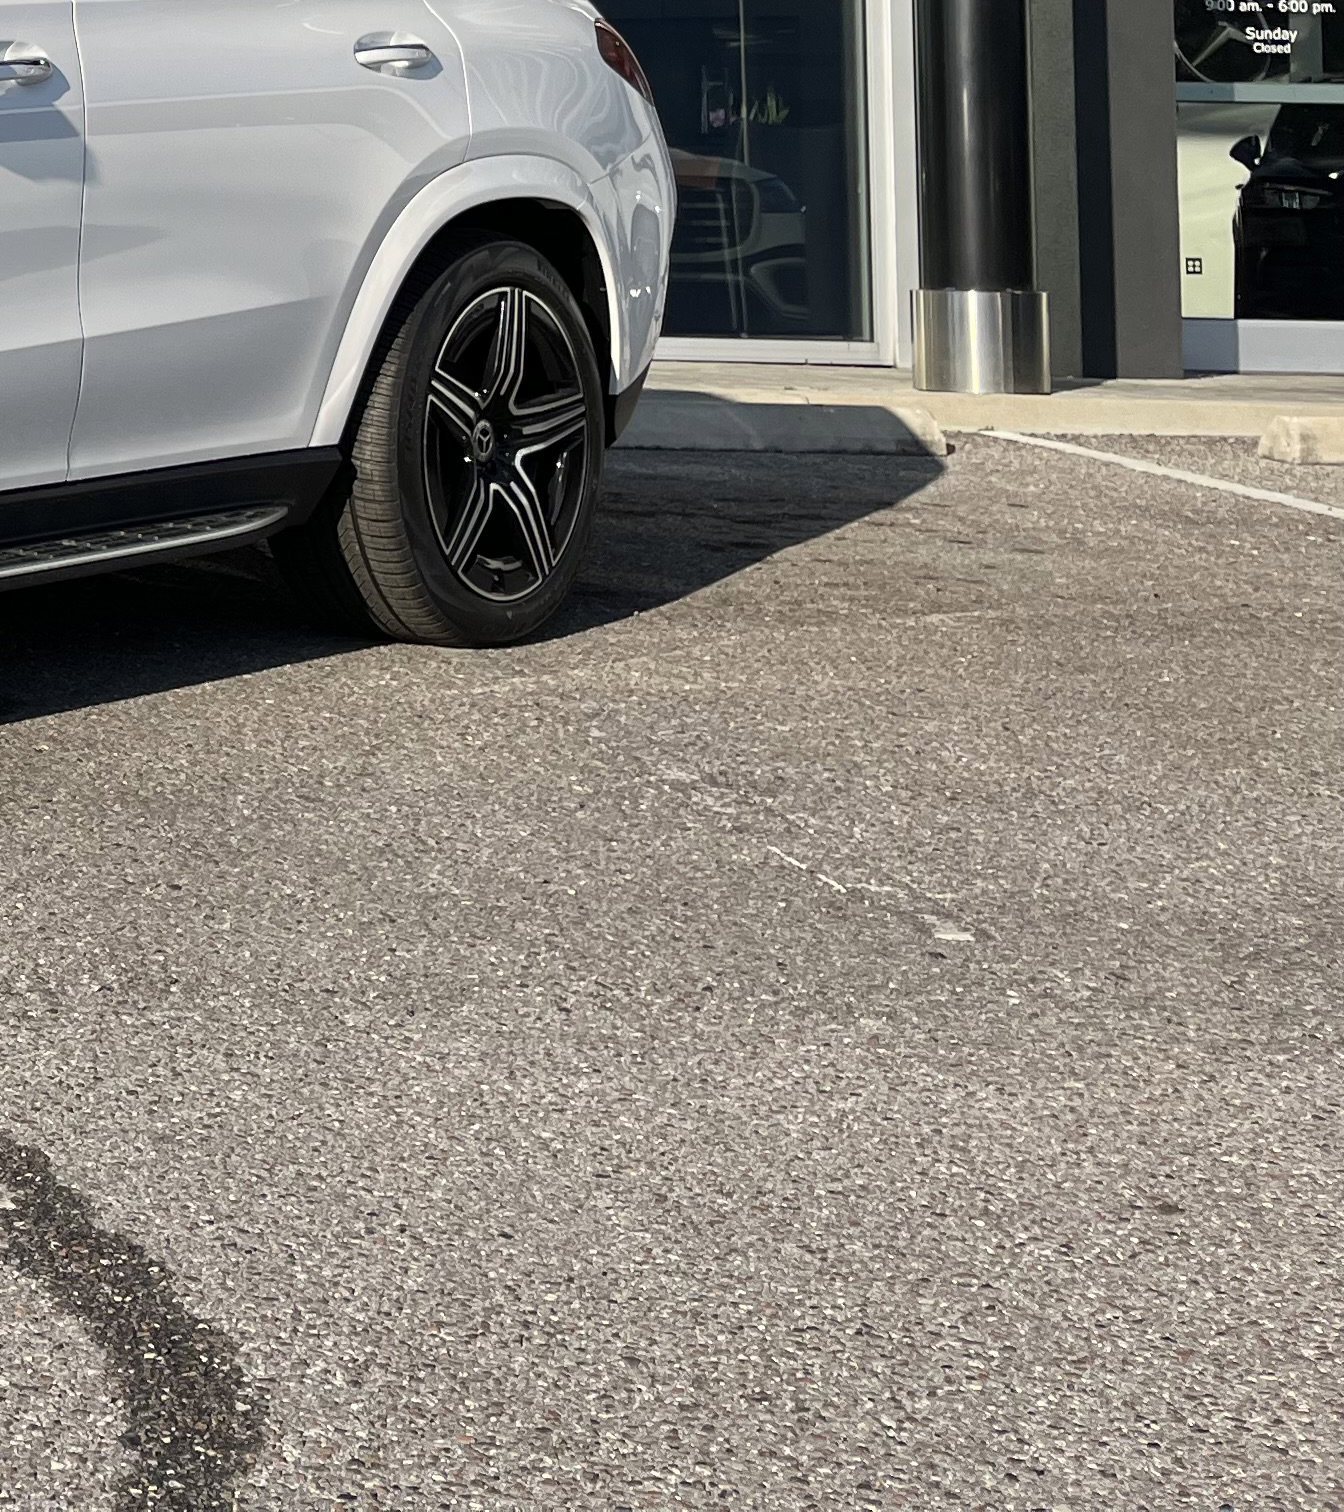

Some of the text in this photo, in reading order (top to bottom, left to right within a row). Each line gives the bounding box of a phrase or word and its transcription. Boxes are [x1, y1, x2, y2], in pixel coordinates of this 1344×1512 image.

[1278, 0, 1309, 13] 6:00
[1245, 26, 1298, 43] Sunday
[1253, 42, 1292, 54] Closed
